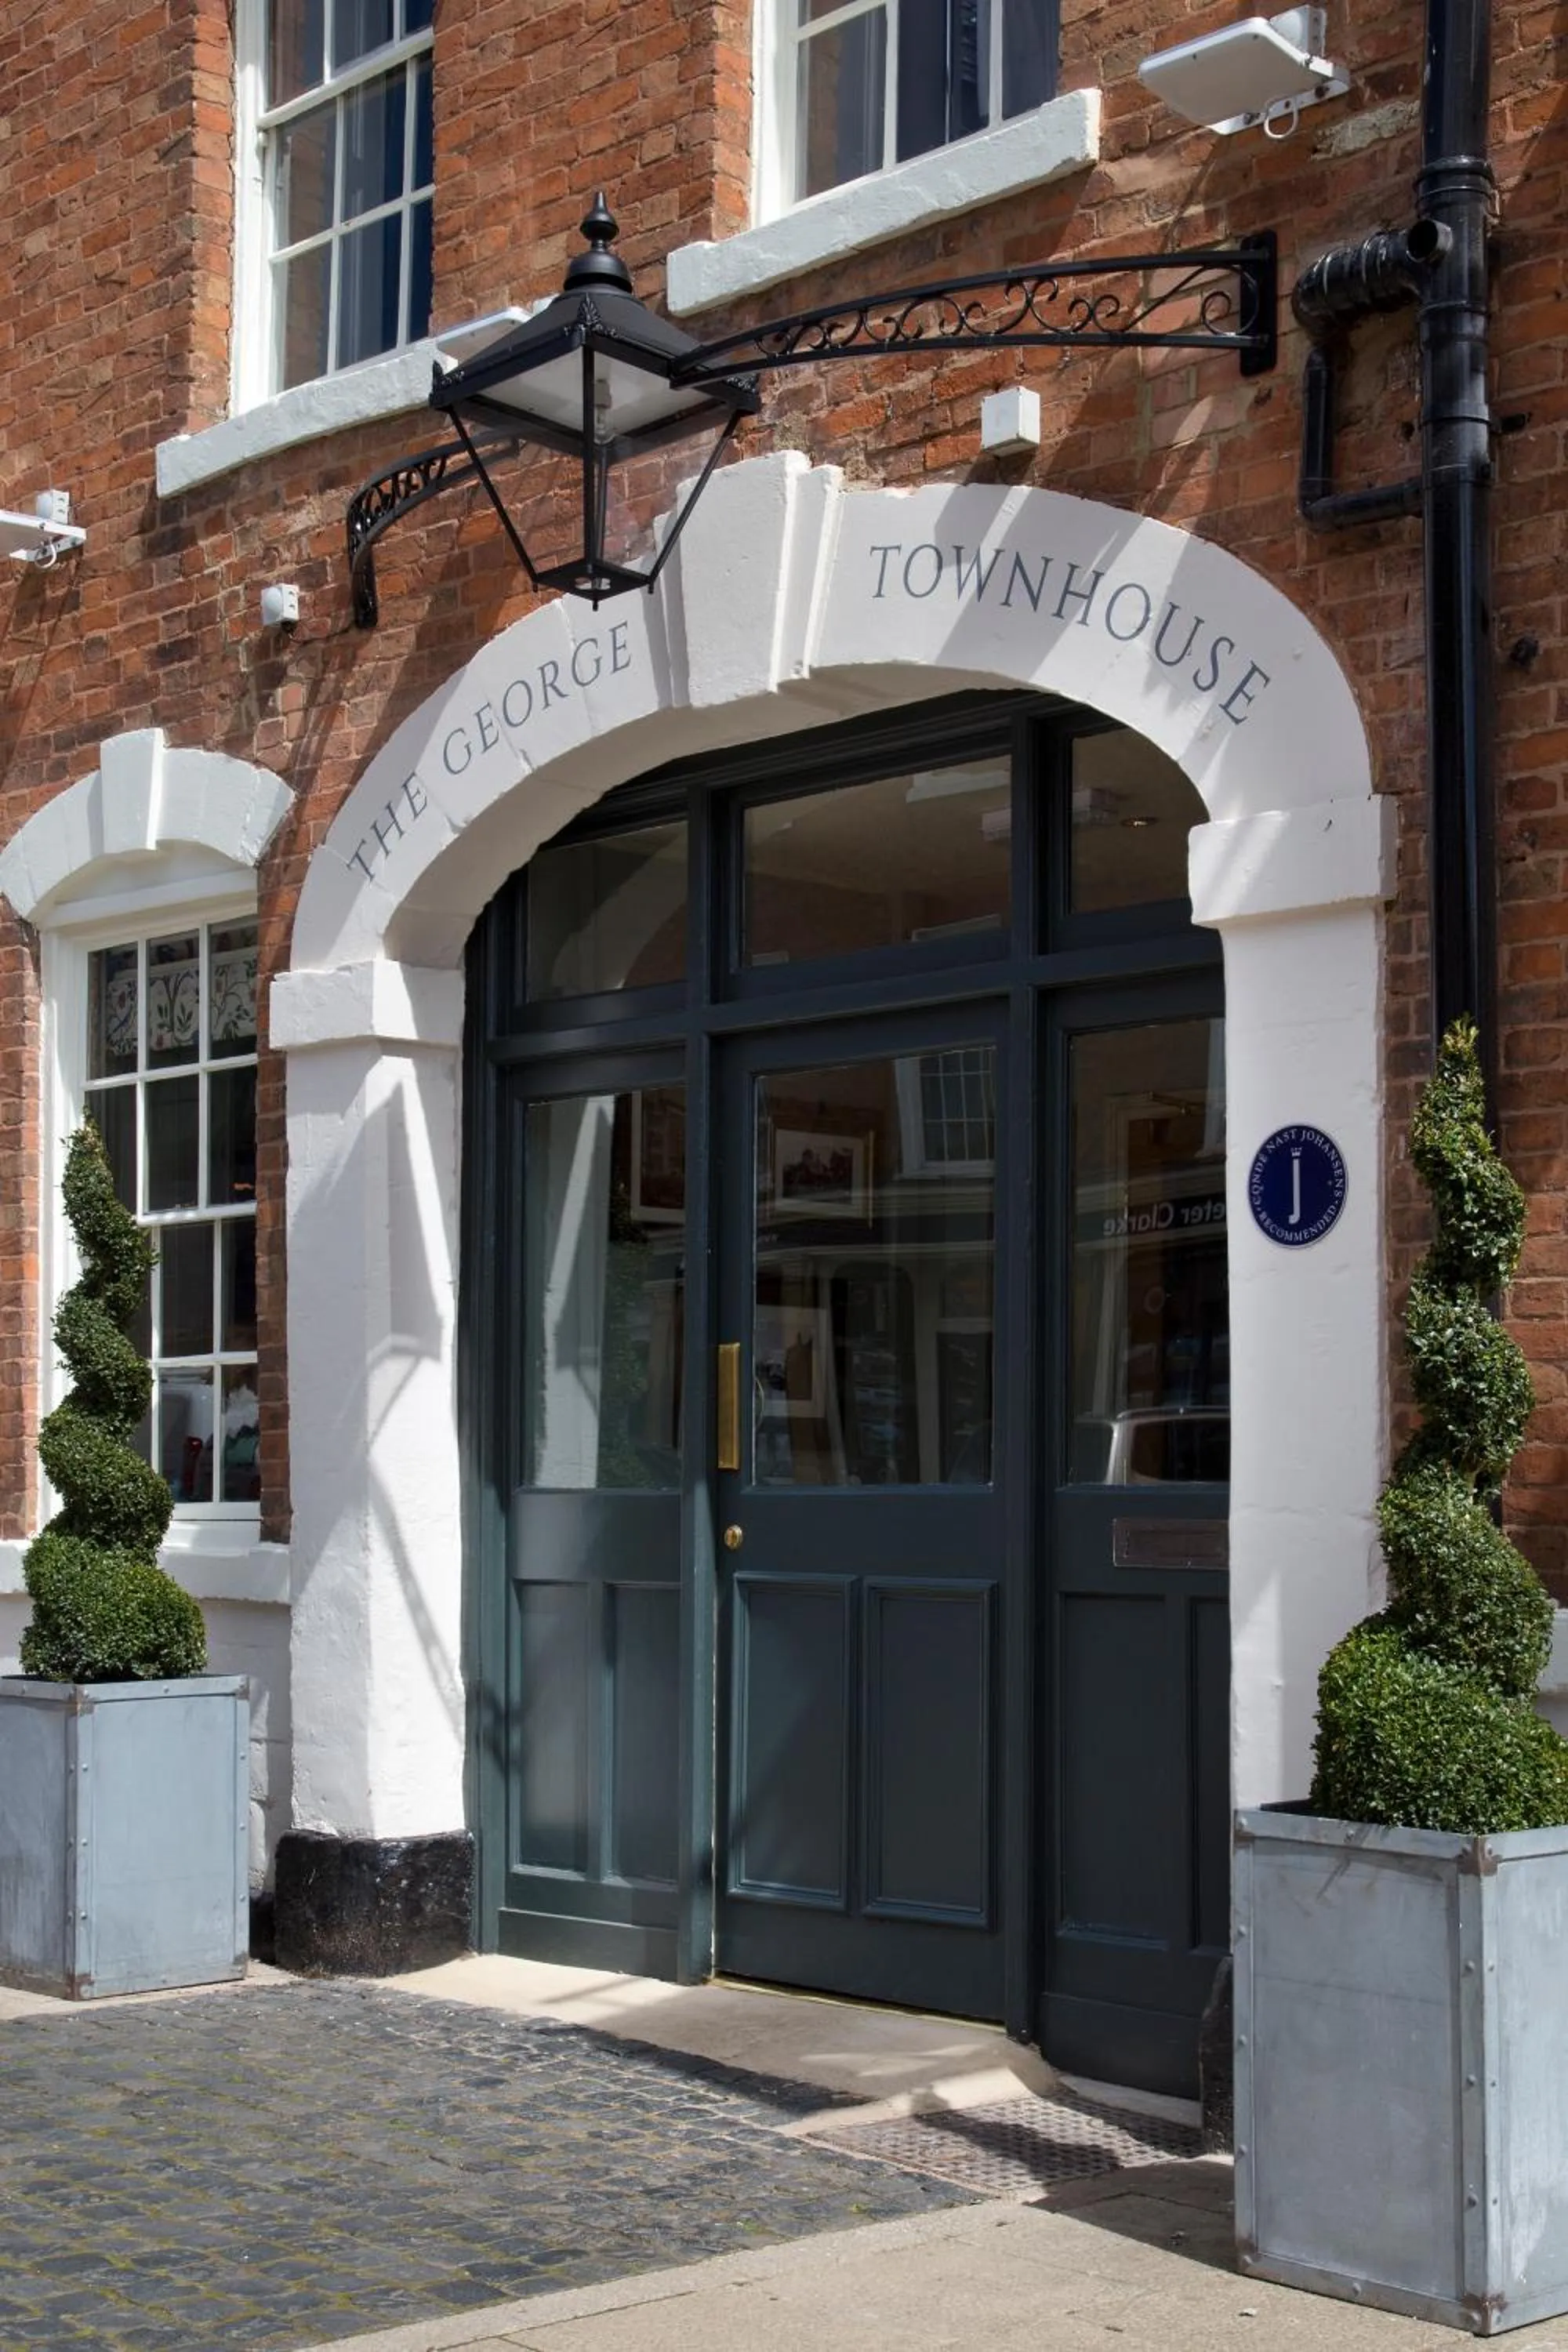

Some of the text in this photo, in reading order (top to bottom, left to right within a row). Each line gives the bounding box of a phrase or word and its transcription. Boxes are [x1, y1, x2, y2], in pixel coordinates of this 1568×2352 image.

[345, 543, 1271, 883] THE GEORGE TOWNHOUSE
[1265, 1129, 1297, 1152] NAST
[1301, 1129, 1345, 1197] JOHANSENS
[1259, 1205, 1337, 1241] RECOMMENDED
